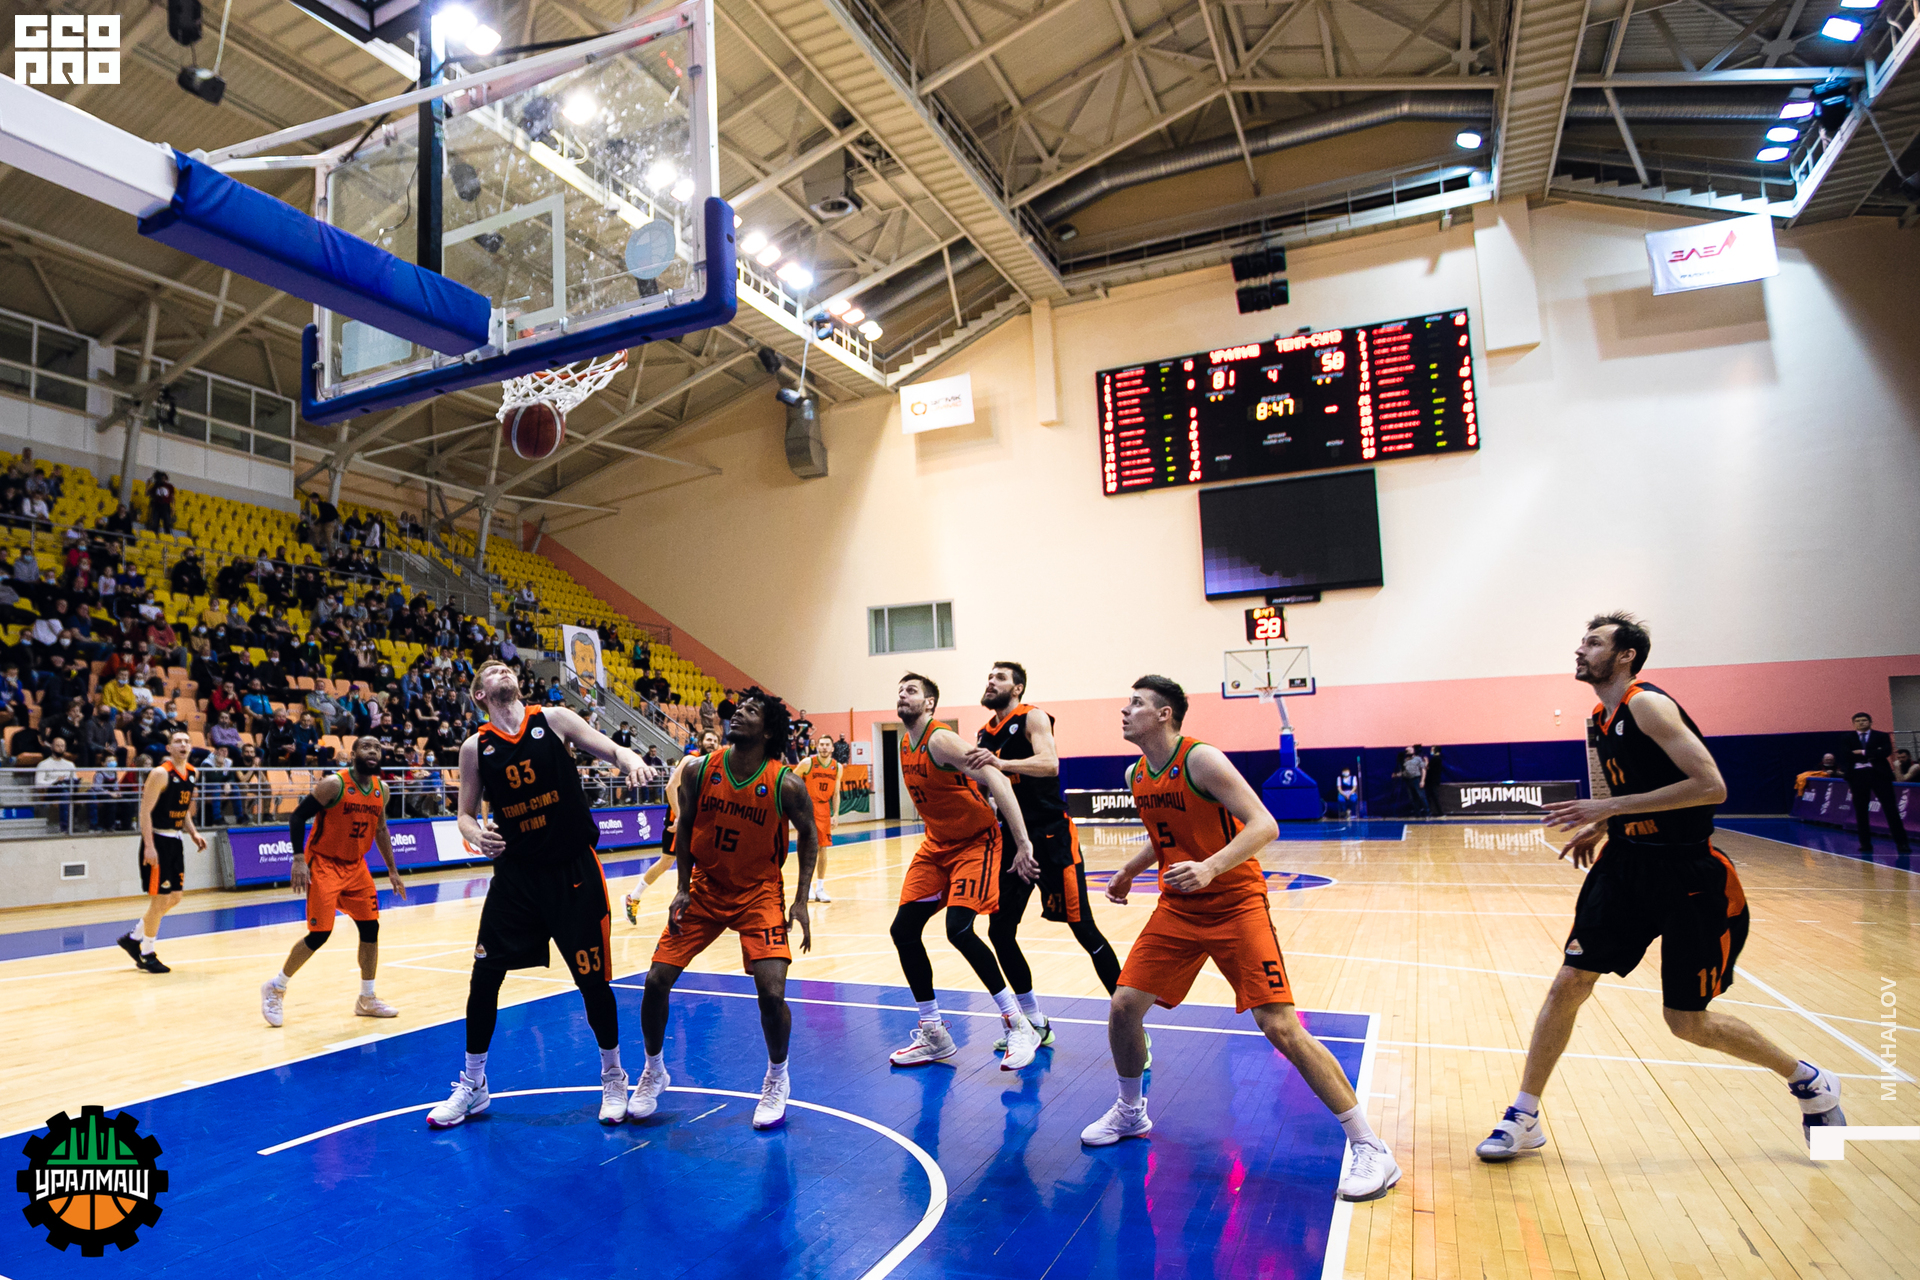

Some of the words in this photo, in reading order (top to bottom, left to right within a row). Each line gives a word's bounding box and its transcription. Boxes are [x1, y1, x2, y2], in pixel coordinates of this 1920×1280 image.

[1321, 351, 1345, 372] 58
[1212, 370, 1236, 390] 81
[1267, 369, 1279, 382] 4
[1256, 398, 1295, 421] 8:47
[1255, 617, 1281, 639] 28
[505, 759, 537, 789] 93
[819, 782, 829, 791] 10
[1460, 786, 1542, 808] УРАЛМАШ
[501, 790, 560, 818] ТЕМП-СУМЗ
[701, 795, 767, 827] УРАЛМАШ
[1091, 795, 1137, 814] УРАЛМ
[1136, 791, 1186, 812] РАЛМАШ
[349, 821, 368, 838] 32
[519, 815, 547, 833] УГМК
[598, 819, 623, 829] molten
[390, 834, 416, 846] olten
[714, 825, 740, 852] 15
[1156, 822, 1175, 848] 5
[259, 840, 294, 855] molte
[953, 878, 976, 898] 31
[762, 926, 787, 946] 15
[575, 947, 601, 975] 93
[1262, 961, 1284, 989] 5
[1696, 966, 1718, 997] 11
